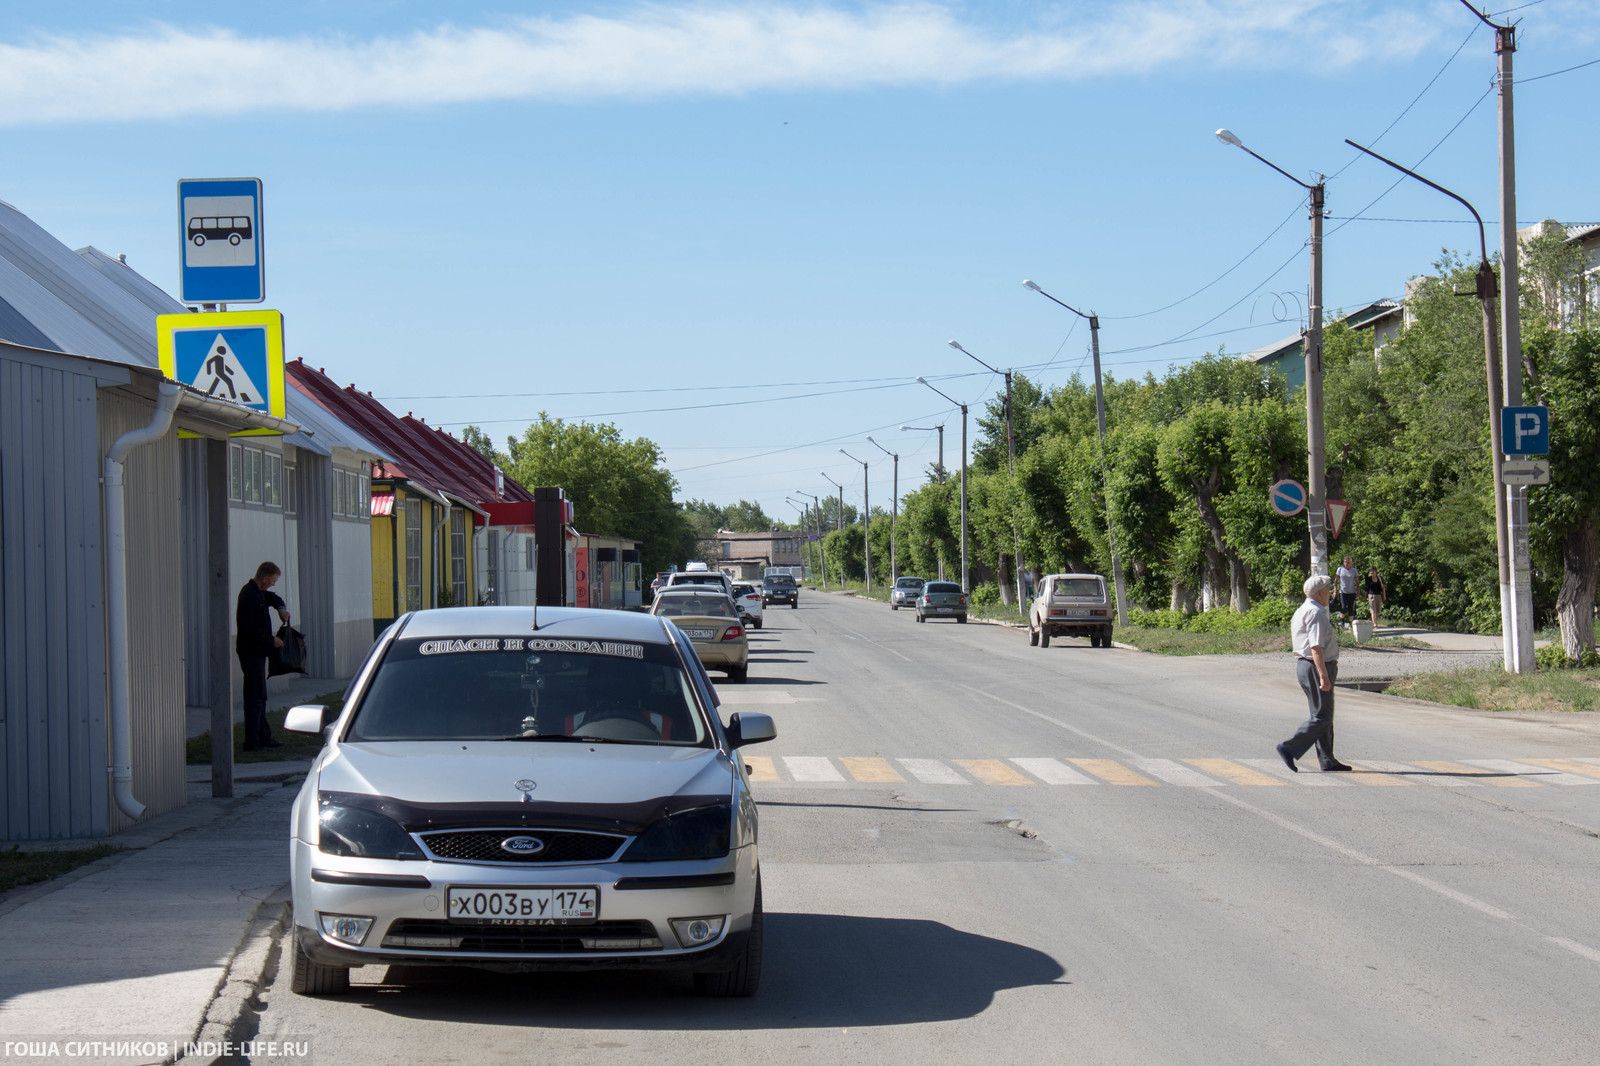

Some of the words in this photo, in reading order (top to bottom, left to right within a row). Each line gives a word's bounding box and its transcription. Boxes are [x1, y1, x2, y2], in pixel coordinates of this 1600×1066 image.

[1514, 412, 1541, 450] P
[418, 638, 500, 656] СПАСИ
[503, 638, 525, 651] И
[512, 839, 535, 849] Ford
[457, 892, 550, 916] Х003ВУ
[555, 891, 591, 910] 174
[562, 909, 580, 917] RUS
